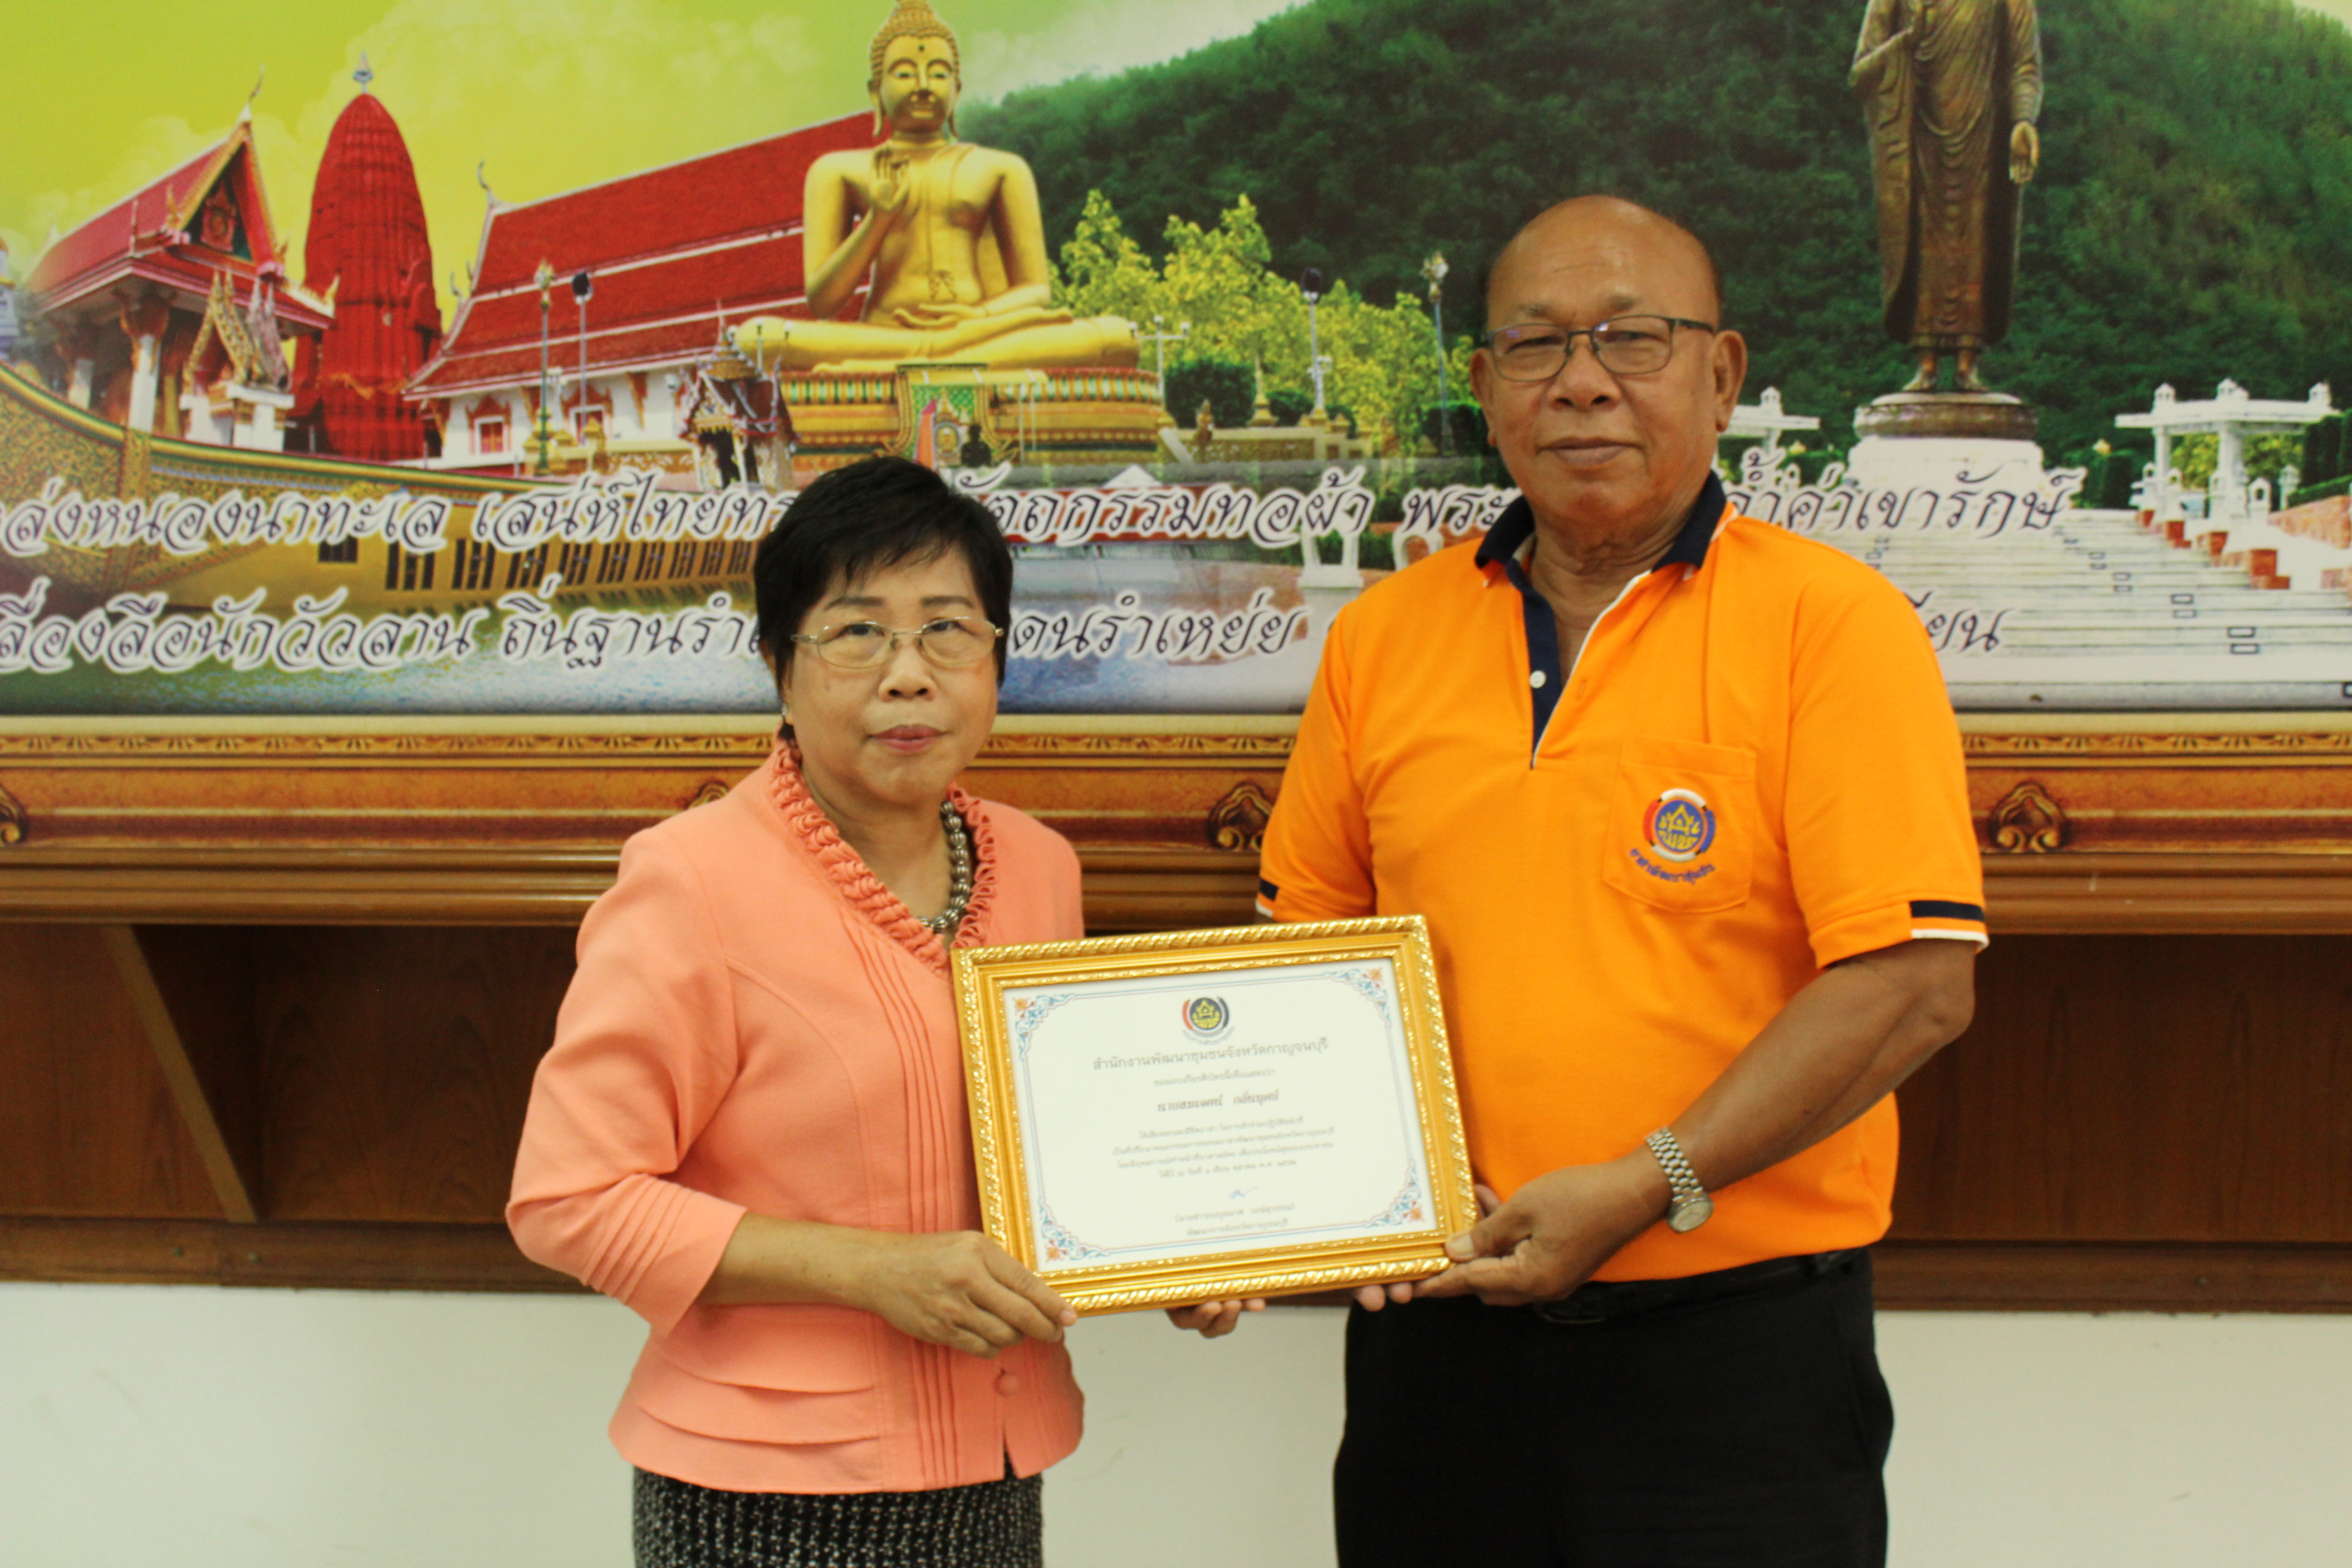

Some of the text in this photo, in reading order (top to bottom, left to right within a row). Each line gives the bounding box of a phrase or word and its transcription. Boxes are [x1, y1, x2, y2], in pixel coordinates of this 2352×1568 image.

[0, 482, 447, 552] ล่งหนองนาทะเล
[959, 466, 1370, 544] ัตถกรรมทอผ้า
[1013, 592, 1307, 653] ดนรำเหย่ย
[1093, 1036, 1328, 1070] สำนักงานพัฒนาชุมชนจังหวัดกาญจนบุรี
